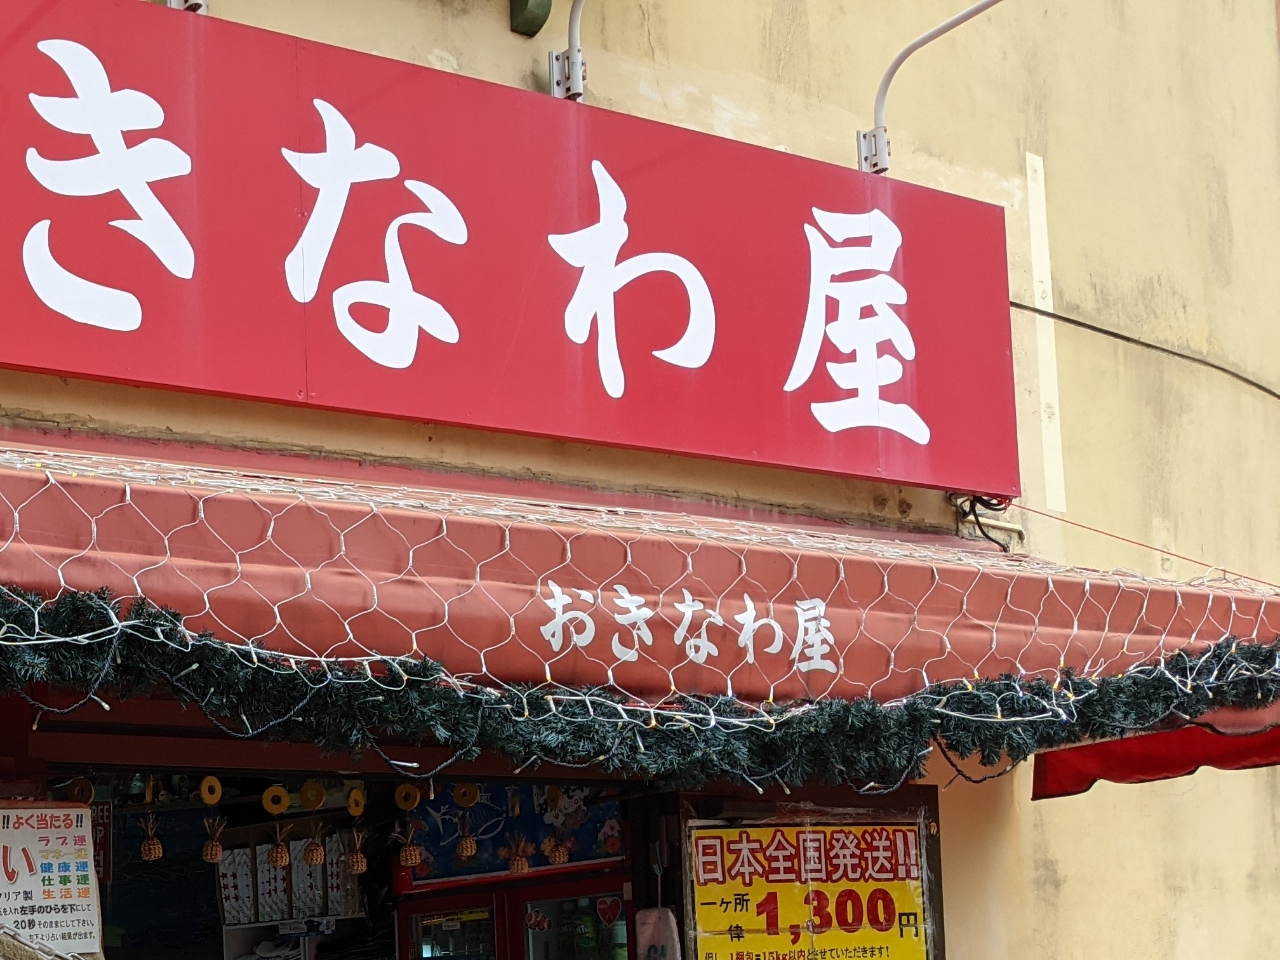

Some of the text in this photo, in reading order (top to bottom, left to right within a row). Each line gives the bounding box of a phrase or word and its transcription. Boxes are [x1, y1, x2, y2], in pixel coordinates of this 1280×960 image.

[540, 579, 838, 673] おきなわ屋
[91, 806, 110, 823] REE
[37, 834, 87, 847] ラブ運
[38, 849, 88, 860] マネー運
[39, 861, 89, 874] 健康運
[41, 874, 90, 887] 仕事運
[42, 887, 91, 900] 生活運
